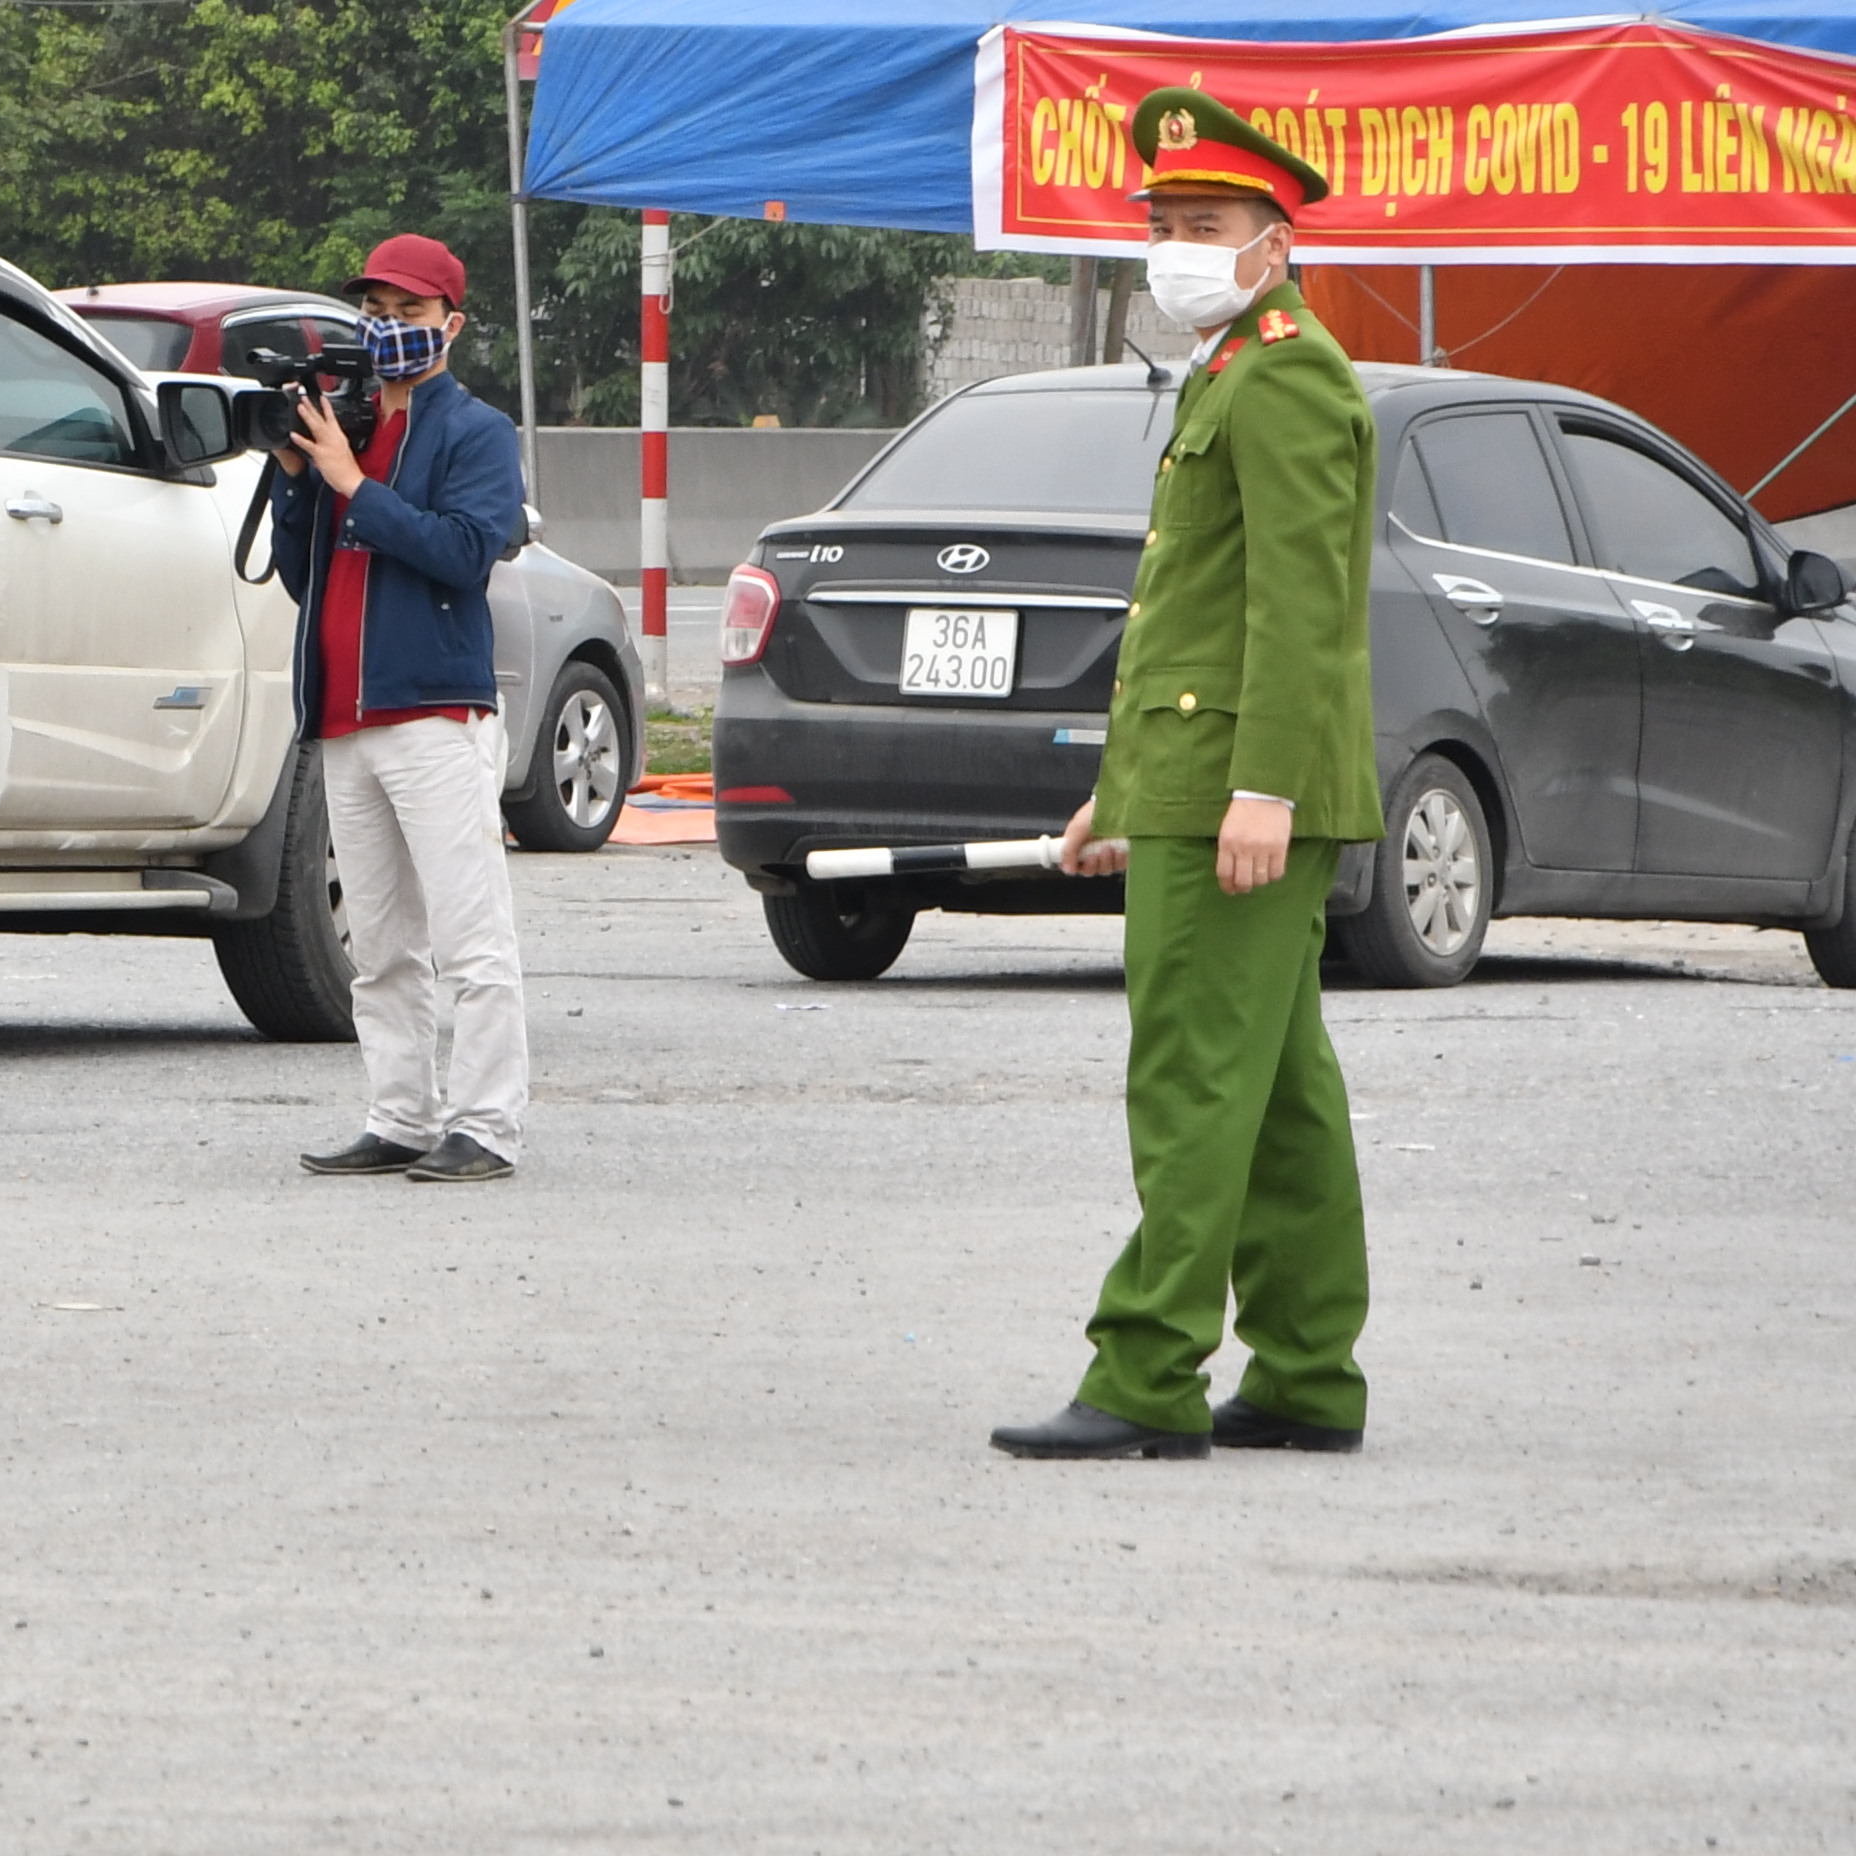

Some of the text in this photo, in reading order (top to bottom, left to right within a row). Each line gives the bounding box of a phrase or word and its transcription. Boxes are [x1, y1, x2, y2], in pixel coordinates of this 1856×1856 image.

[1030, 73, 1127, 189] CHỐT
[1359, 105, 1454, 217] DỊCH
[1465, 102, 1580, 196] COVID
[1621, 101, 1668, 194] 19
[1680, 83, 1770, 194] LIÊN
[932, 614, 986, 650] 36A
[905, 653, 1007, 690] 243.00
